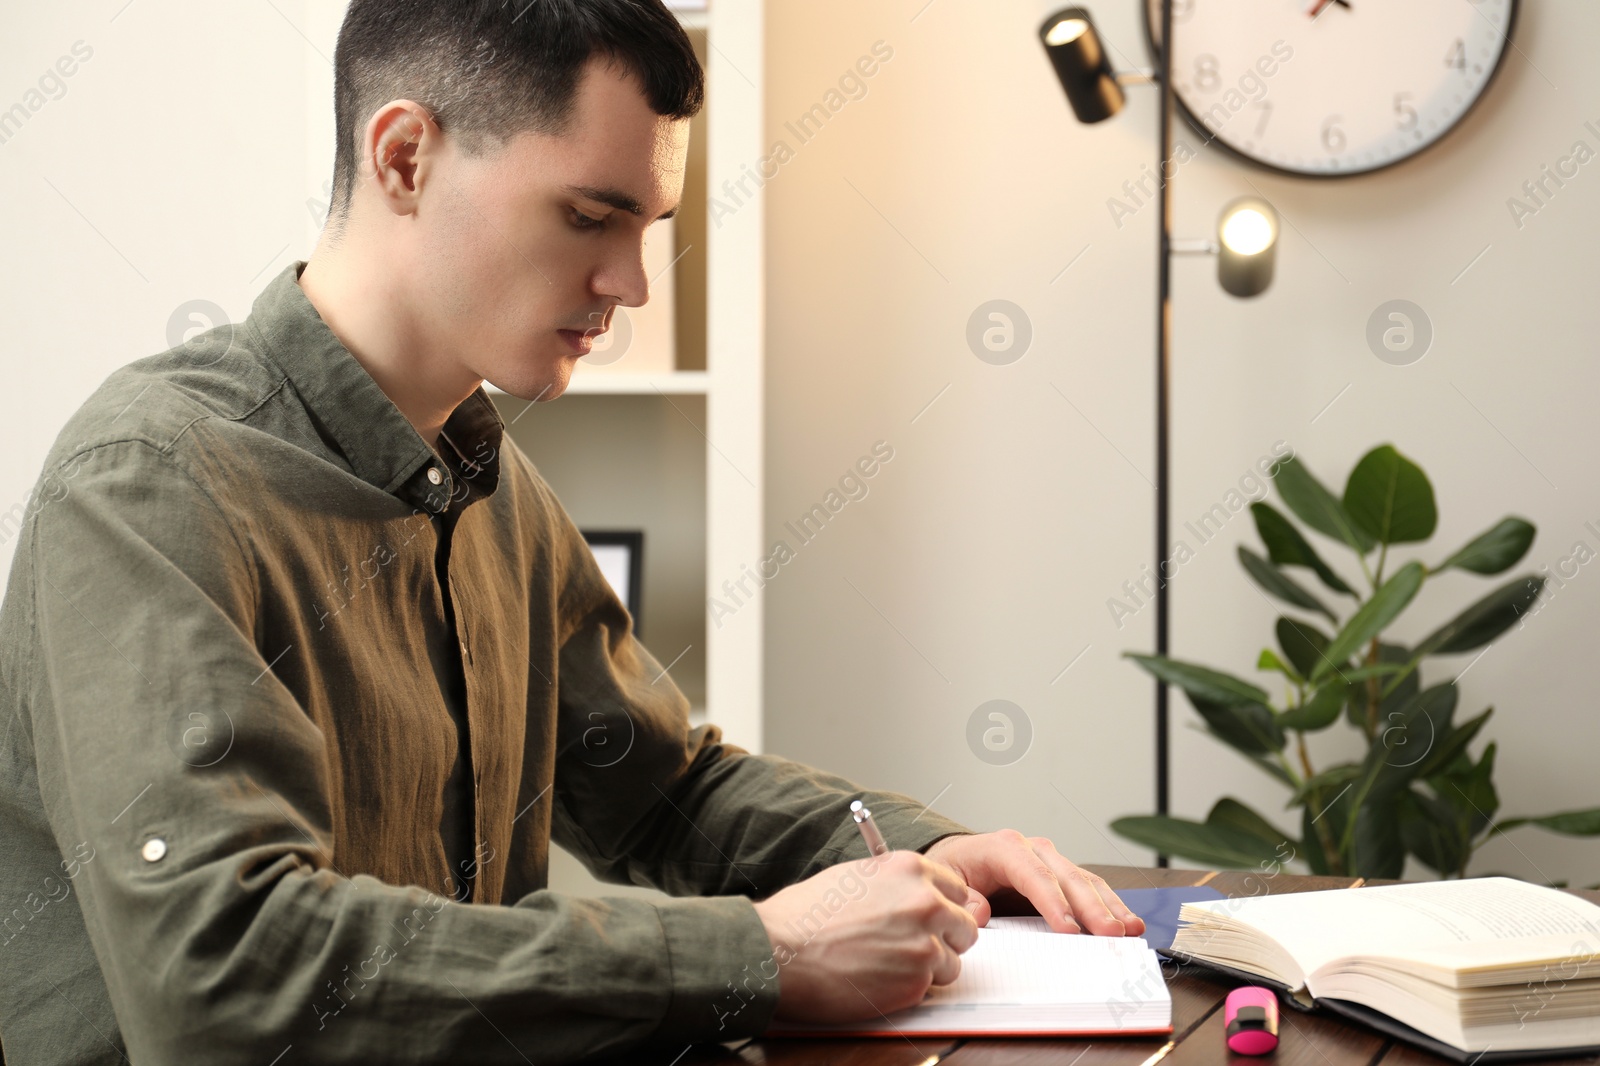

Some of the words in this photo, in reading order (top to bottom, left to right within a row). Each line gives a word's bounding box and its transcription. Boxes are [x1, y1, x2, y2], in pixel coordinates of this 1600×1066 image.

[1193, 53, 1222, 94] 8
[1443, 37, 1467, 73] 4
[1252, 101, 1274, 140] 7
[1393, 91, 1419, 132] 5
[1320, 114, 1347, 155] 6
